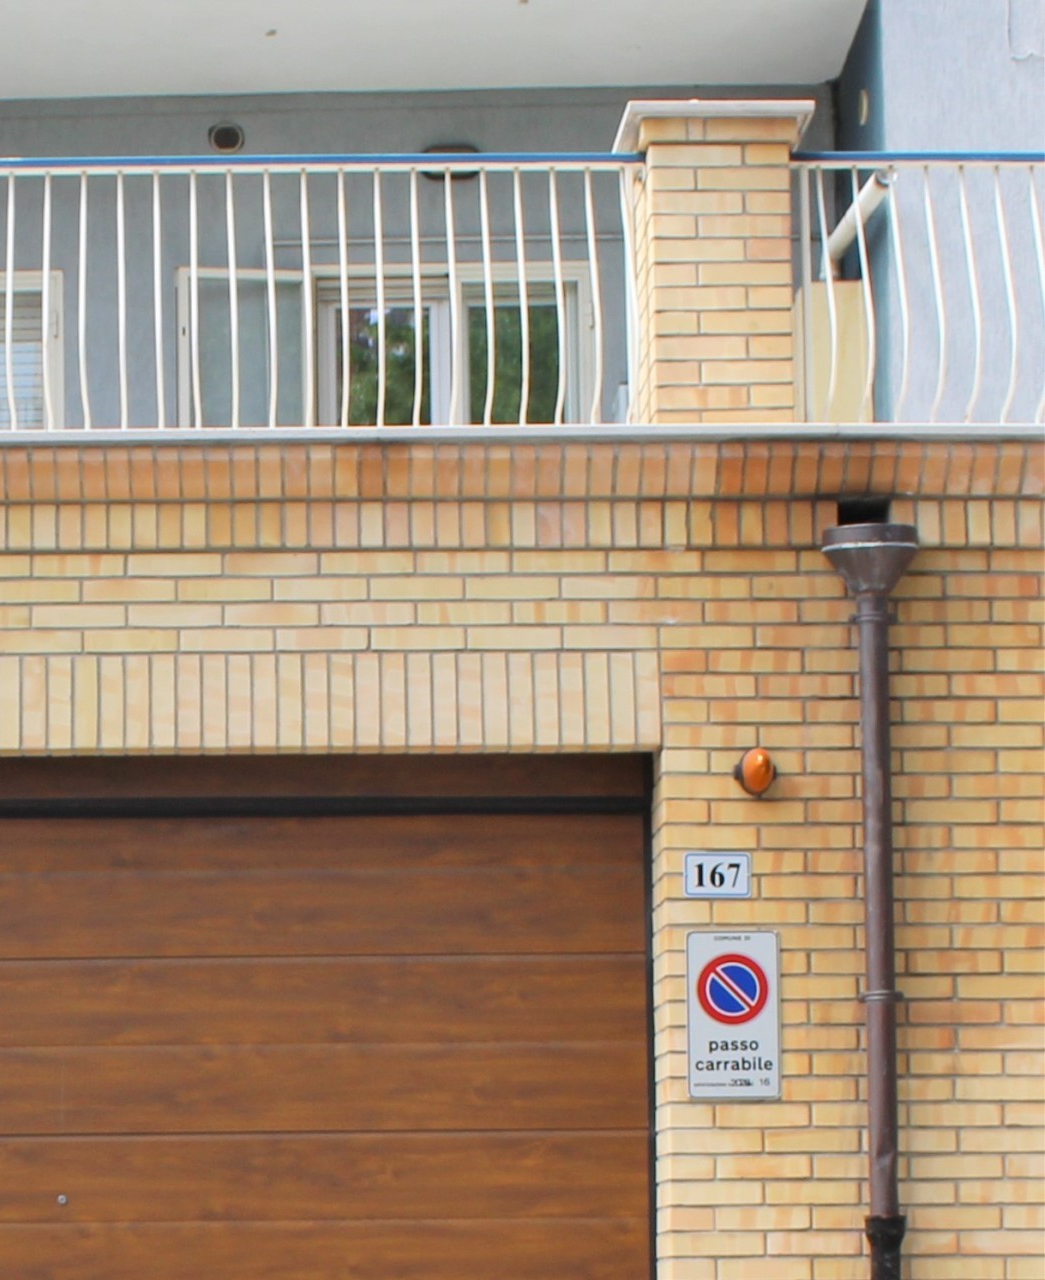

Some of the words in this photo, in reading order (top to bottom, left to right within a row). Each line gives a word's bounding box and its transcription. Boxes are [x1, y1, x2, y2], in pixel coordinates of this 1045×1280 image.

[695, 862, 741, 888] 167
[708, 1040, 759, 1054] passo
[695, 1057, 773, 1071] carrabile
